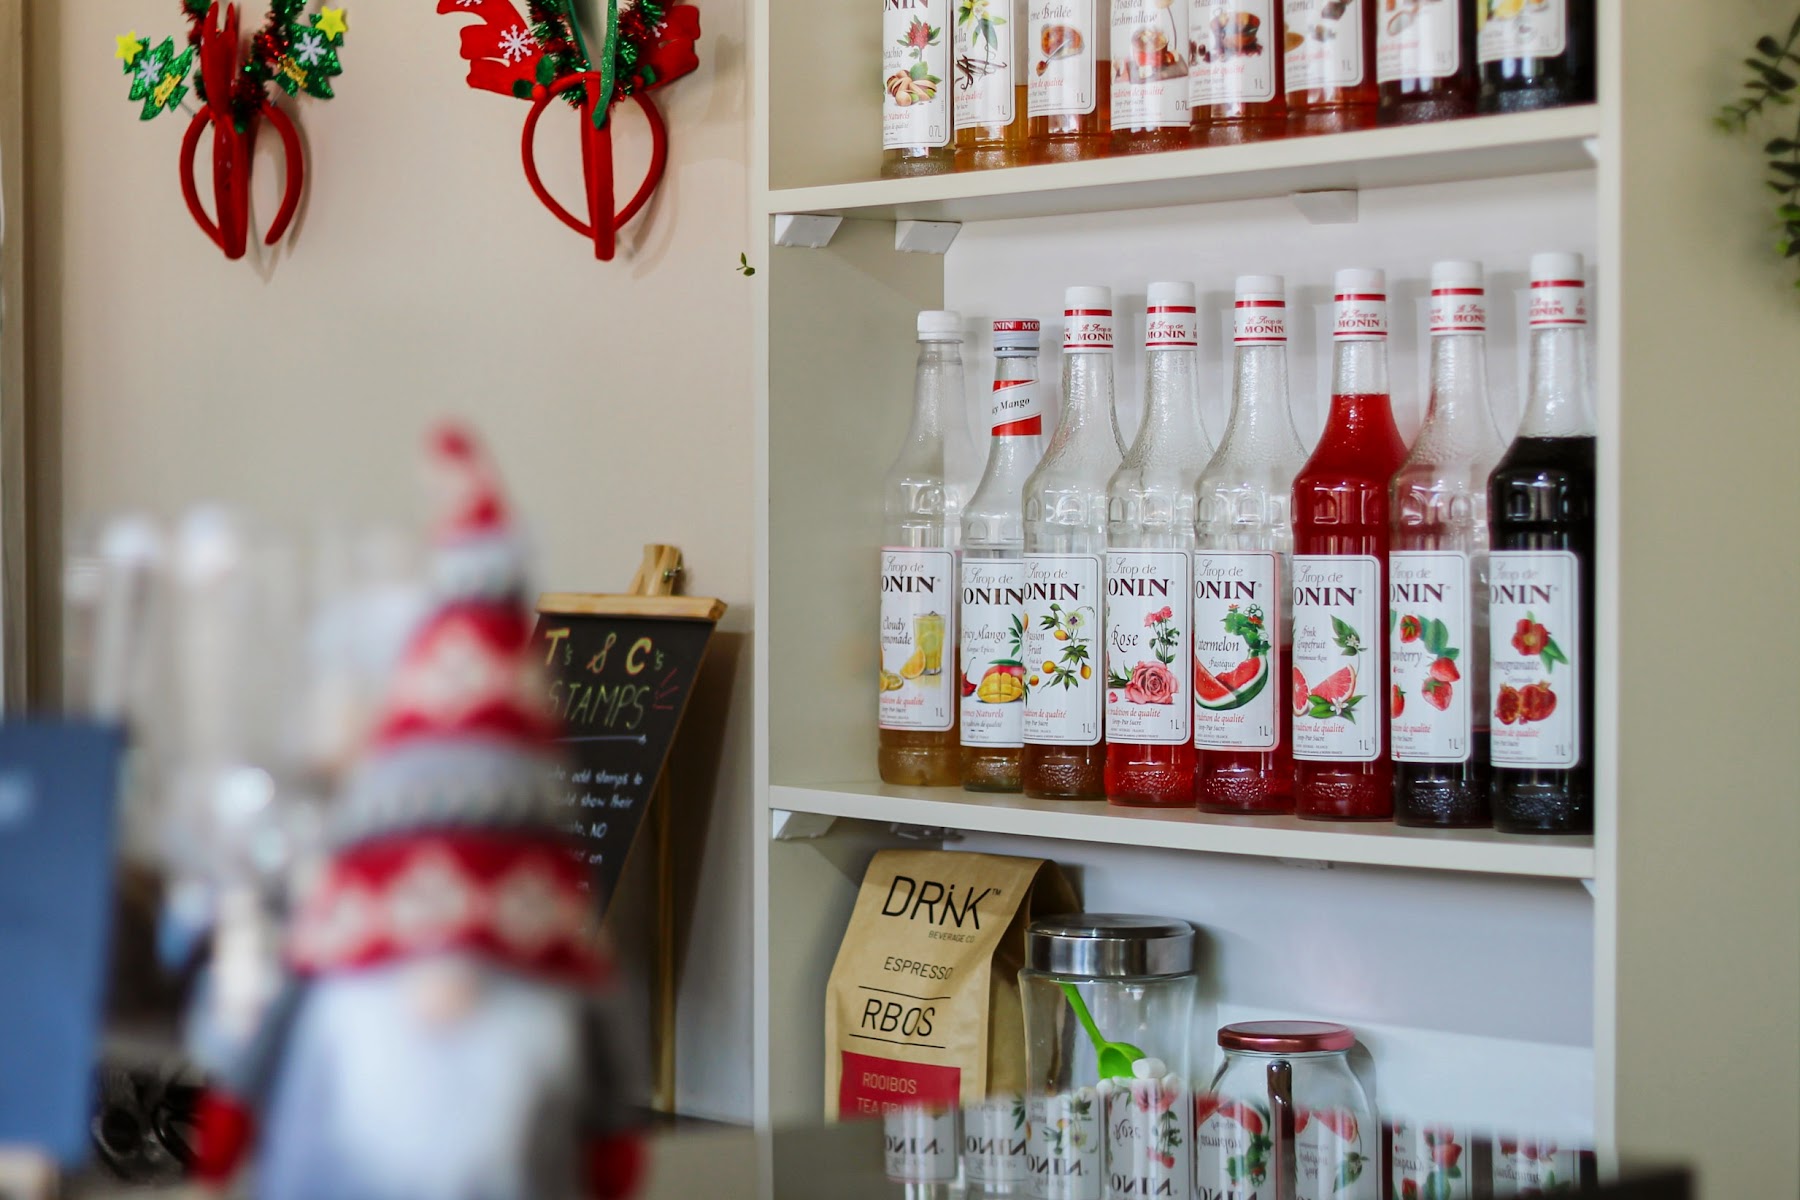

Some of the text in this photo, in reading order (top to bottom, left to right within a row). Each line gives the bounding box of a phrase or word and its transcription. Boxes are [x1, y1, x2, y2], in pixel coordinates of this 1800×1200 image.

[1042, 2, 1071, 19] Brûlée
[1175, 100, 1188, 111] 0.7L
[1245, 325, 1284, 333] MONIN
[1338, 319, 1380, 328] MONIN
[1147, 330, 1186, 339] MONIN
[1000, 397, 1030, 412] Mango
[885, 555, 924, 576] Sirop de
[1028, 562, 1067, 582] Sirop de
[1112, 556, 1157, 578] Sirop de
[1200, 559, 1243, 580] Sirop de
[969, 567, 1013, 587] Sirop de
[1298, 565, 1343, 588] Sirop de
[1024, 582, 1080, 601] ONIN
[1195, 580, 1256, 600] ONIN
[1294, 586, 1357, 606] ONIN
[972, 623, 1007, 644] Mango
[1110, 623, 1139, 654] Rose
[549, 679, 651, 731] STAMPS
[976, 708, 1004, 718] Naturels
[1045, 708, 1067, 721] qualité
[1130, 707, 1137, 717] de
[1138, 707, 1160, 720] qualité
[1221, 712, 1245, 725] qualité
[1321, 722, 1344, 735] qualité
[590, 821, 608, 839] NO
[928, 929, 965, 944] BEVERAGE
[884, 956, 954, 981] ESPRESSO
[861, 998, 936, 1038] RBOS
[863, 1072, 918, 1095] ROOIBOS
[856, 1097, 880, 1115] TEA
